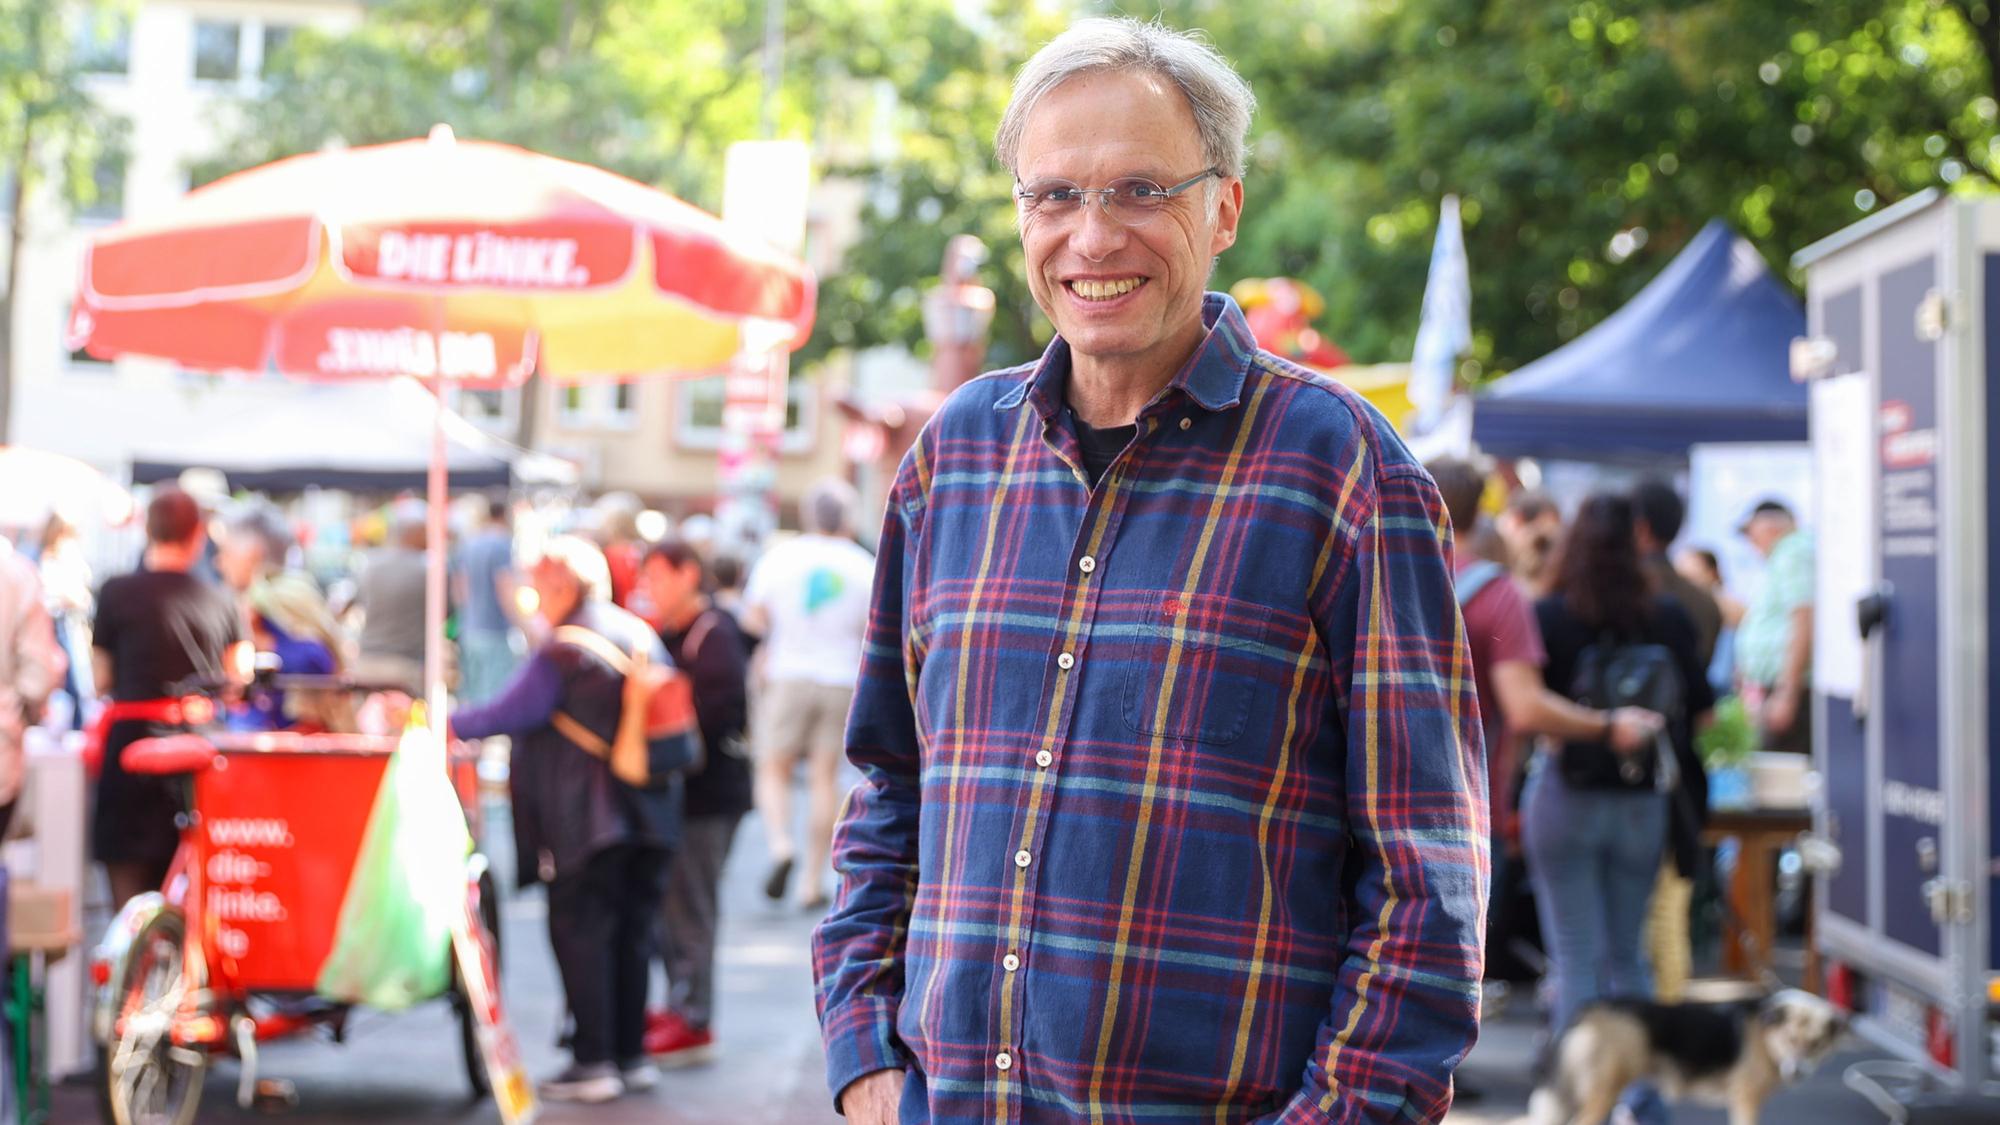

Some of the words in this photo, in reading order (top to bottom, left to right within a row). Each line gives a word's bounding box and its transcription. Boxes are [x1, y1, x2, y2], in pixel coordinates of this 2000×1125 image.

[378, 230, 449, 281] DIE
[208, 818, 295, 847] www.
[207, 848, 271, 884] die-
